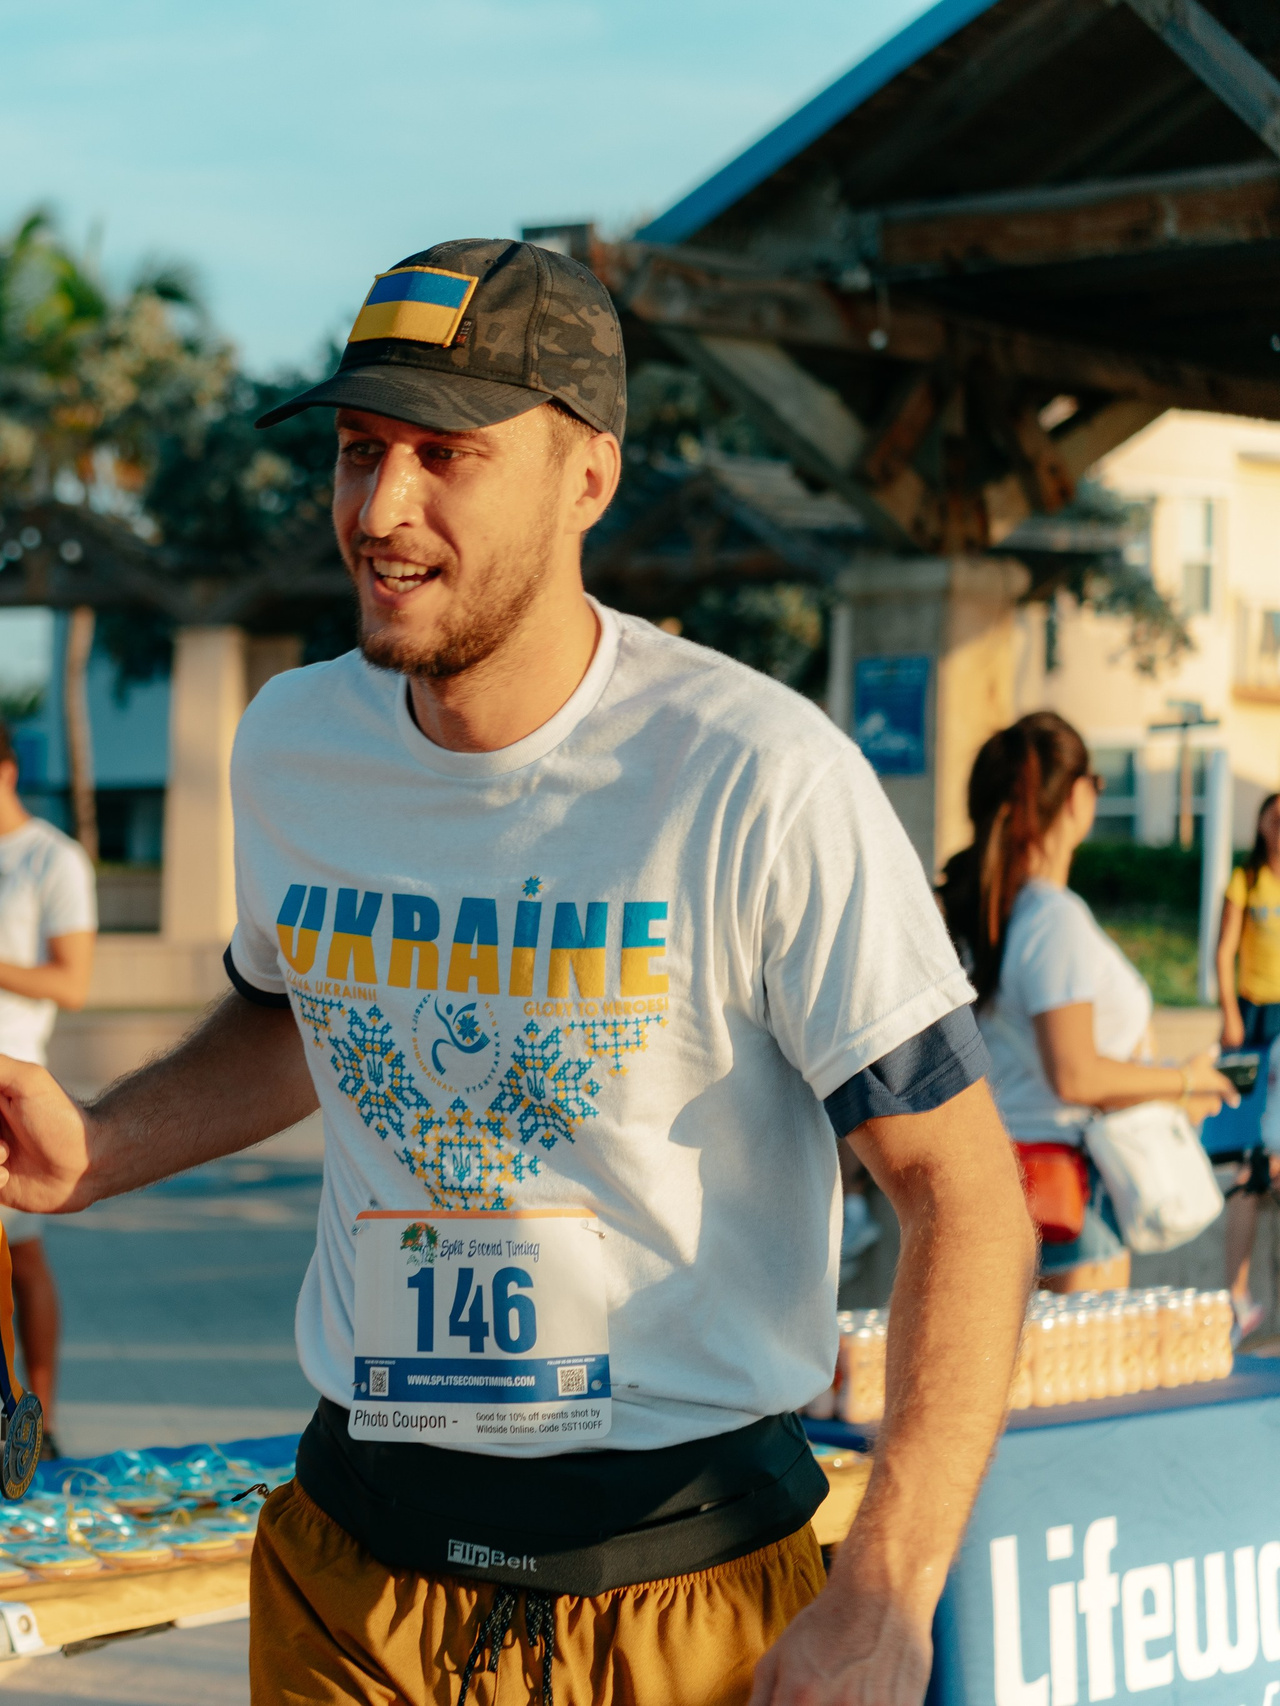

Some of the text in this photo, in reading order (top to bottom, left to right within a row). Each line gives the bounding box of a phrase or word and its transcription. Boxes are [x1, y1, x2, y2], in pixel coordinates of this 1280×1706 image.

[276, 883, 670, 998] UKRAINE
[523, 996, 669, 1018] GLORY TO HEROES!
[440, 1239, 540, 1263] Split Second Timing
[407, 1266, 538, 1355] 146
[407, 1374, 536, 1387] WWW.SPLITSECONDTIMING.COM
[353, 1409, 389, 1428] Photo
[392, 1410, 447, 1432] Coupon
[475, 1408, 601, 1422] Good for 10% off events shot by
[476, 1424, 508, 1434] Wildside
[538, 1422, 559, 1433] Code
[447, 1538, 537, 1573] FlipBelt
